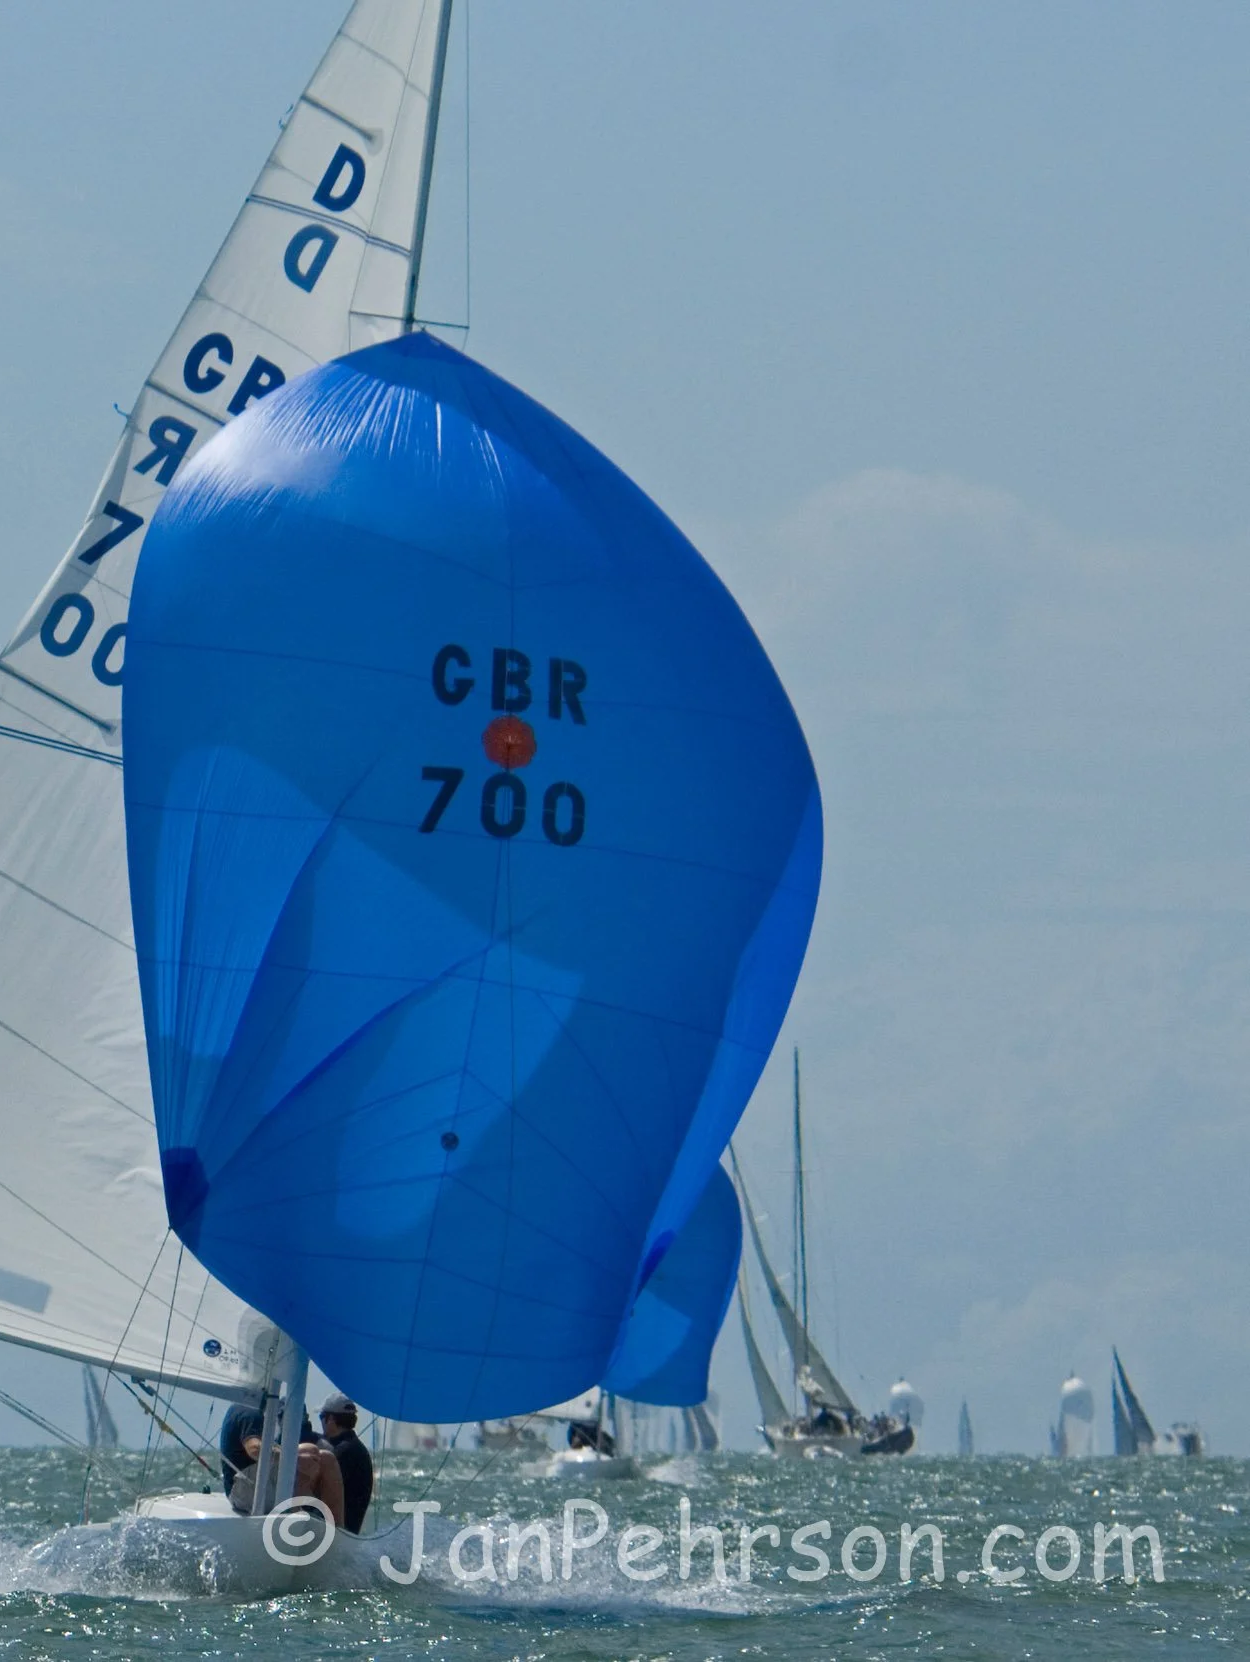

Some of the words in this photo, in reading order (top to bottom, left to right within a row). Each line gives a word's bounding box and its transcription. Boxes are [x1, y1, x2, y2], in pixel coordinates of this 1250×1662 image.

[312, 144, 365, 212] D
[78, 500, 144, 565] 7
[432, 644, 587, 726] GBR
[418, 765, 586, 847] 700
